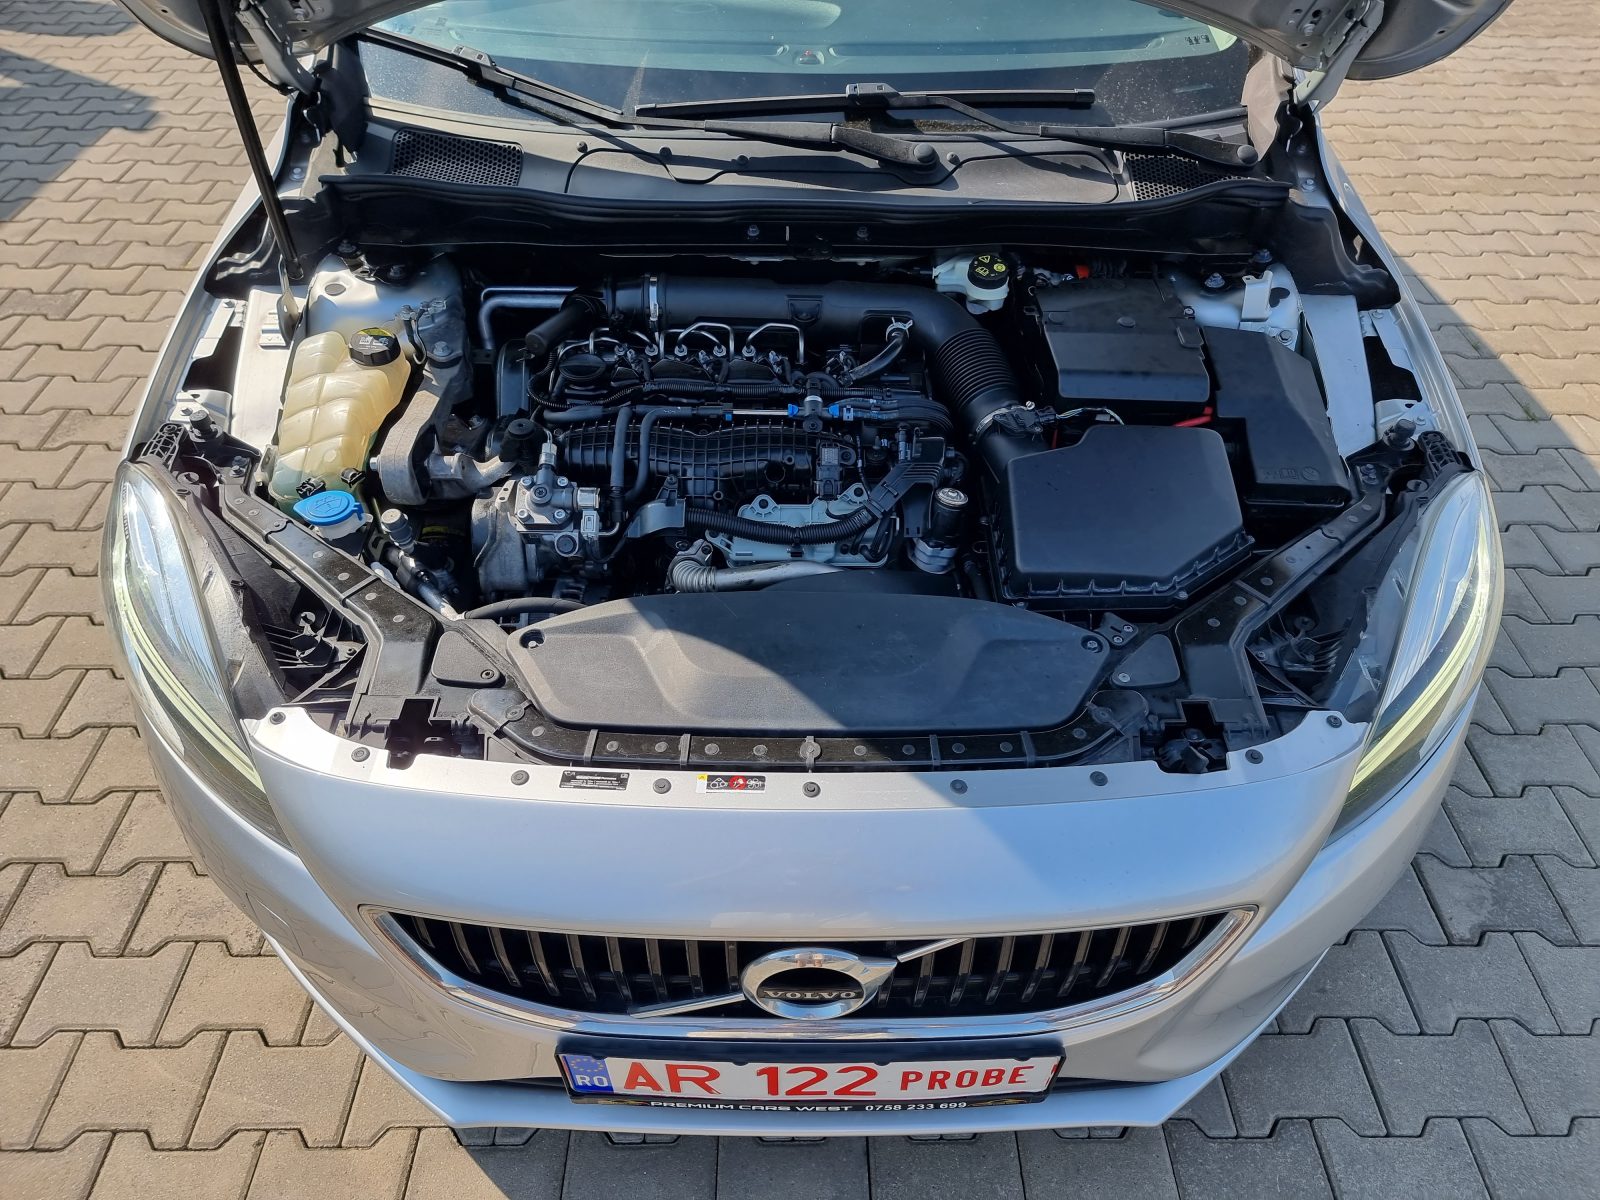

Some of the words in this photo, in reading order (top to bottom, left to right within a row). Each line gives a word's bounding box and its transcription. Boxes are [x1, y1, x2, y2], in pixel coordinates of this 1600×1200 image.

[763, 990, 857, 999] VOLVO
[576, 1074, 608, 1087] RO
[623, 1061, 722, 1095] AR
[756, 1065, 879, 1096] 122
[900, 1065, 1035, 1091] PROBE
[650, 1101, 734, 1110] PREMIUM
[865, 1103, 902, 1112] 0758
[907, 1102, 935, 1111] 233
[939, 1101, 968, 1110] 699
